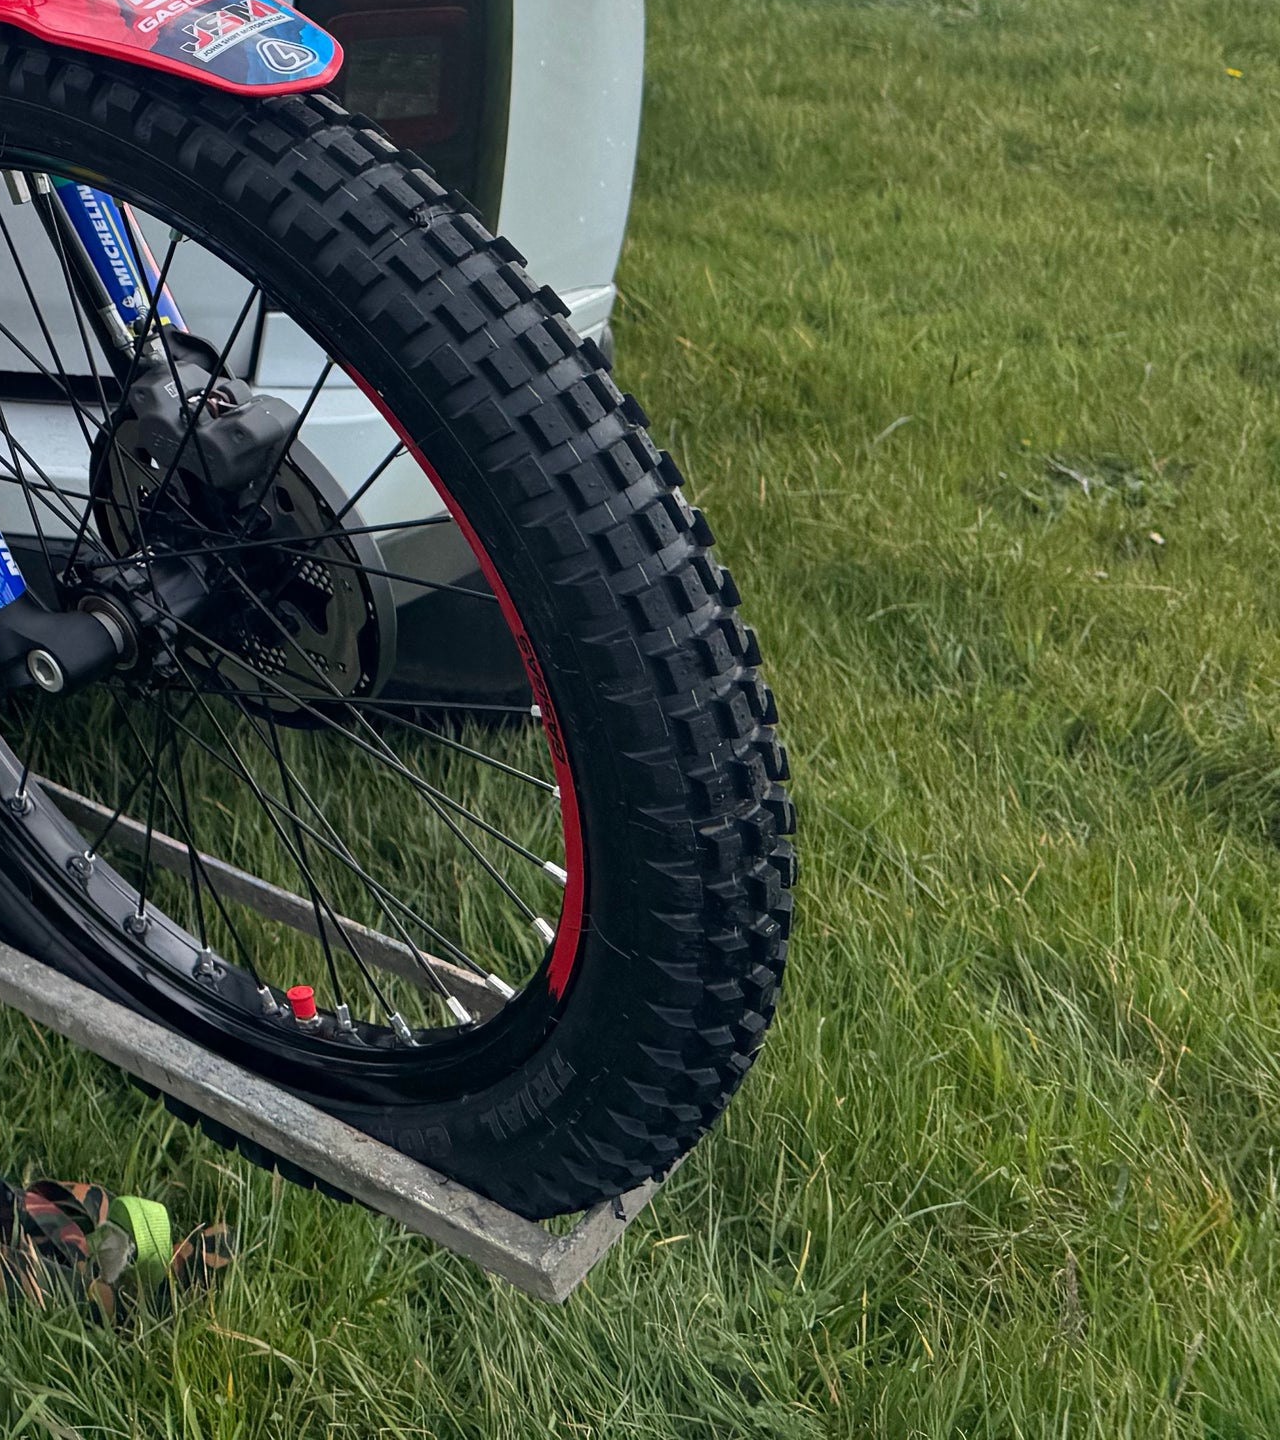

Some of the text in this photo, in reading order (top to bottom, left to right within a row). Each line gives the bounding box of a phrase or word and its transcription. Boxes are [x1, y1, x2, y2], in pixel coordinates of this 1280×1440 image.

[203, 14, 287, 58] JOHN SHIRT MOTORCYCLES
[75, 184, 134, 287] MICHELIN
